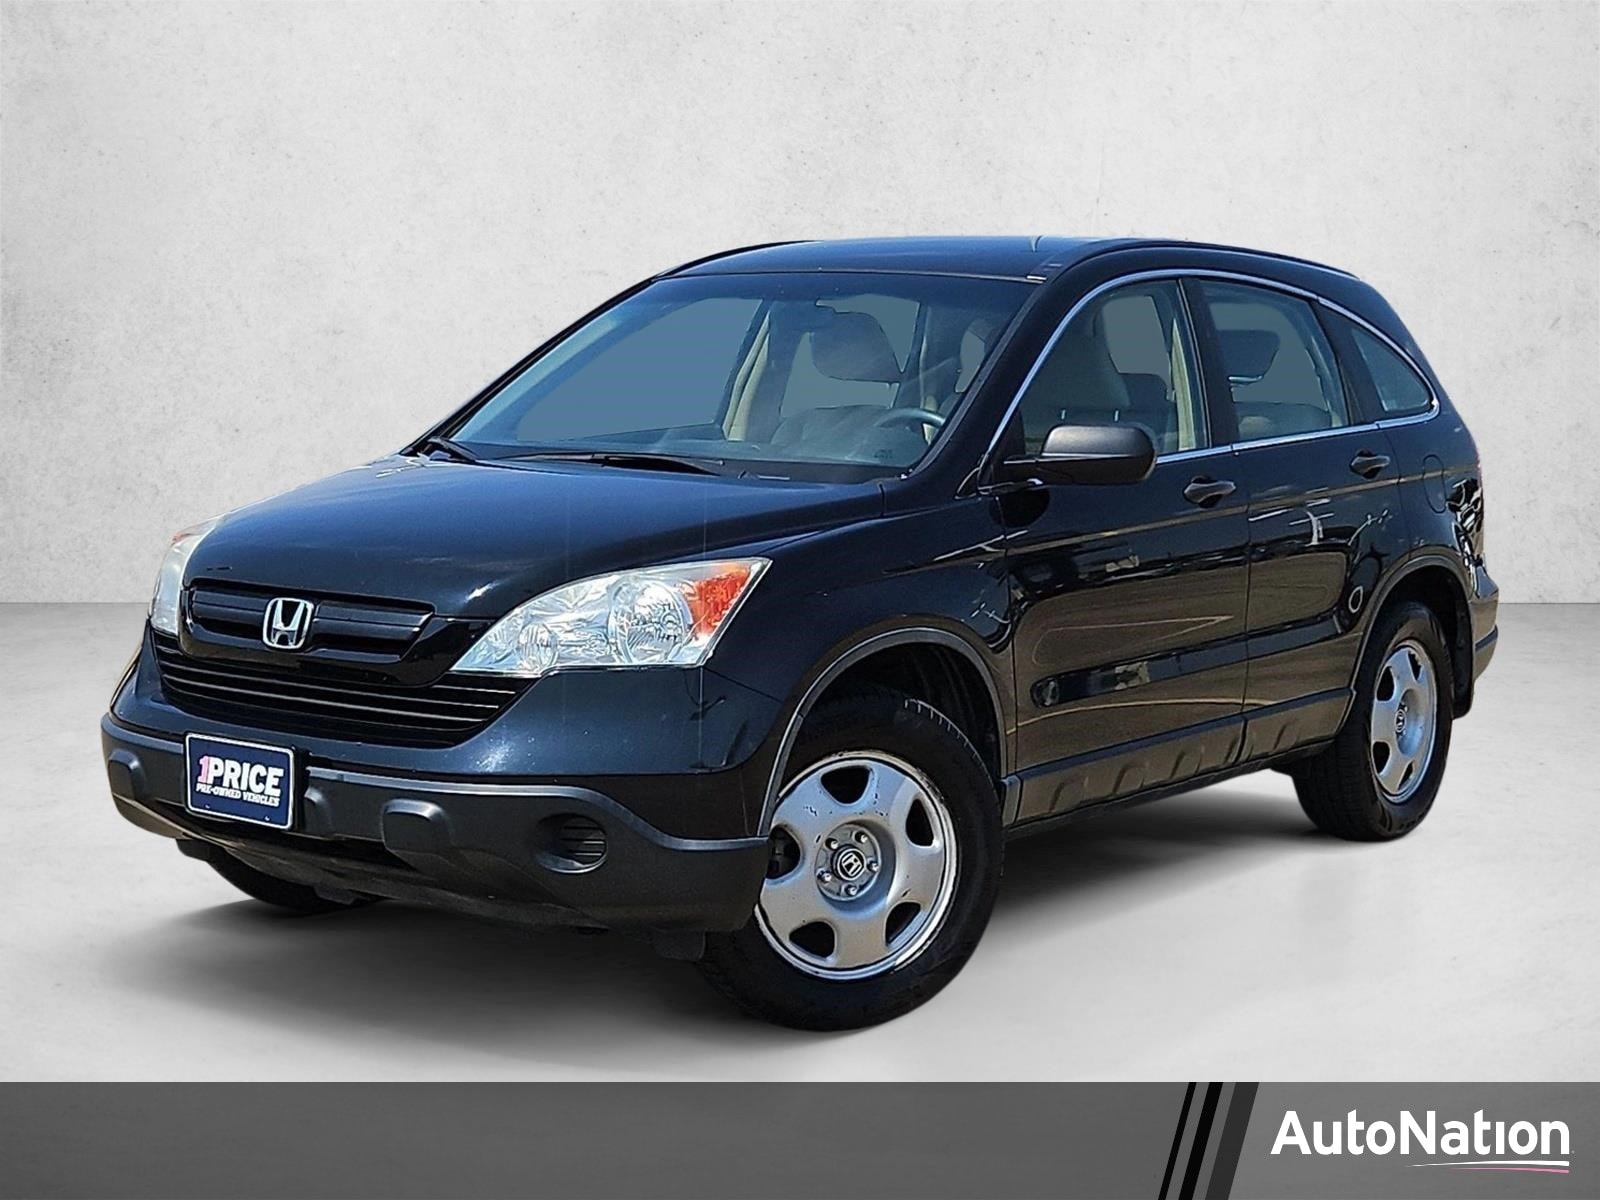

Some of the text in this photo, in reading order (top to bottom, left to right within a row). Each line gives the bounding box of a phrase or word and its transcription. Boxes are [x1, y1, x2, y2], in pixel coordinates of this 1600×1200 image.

[269, 598, 307, 647] H
[195, 782, 280, 807] PRE-OWNED VEHICLES
